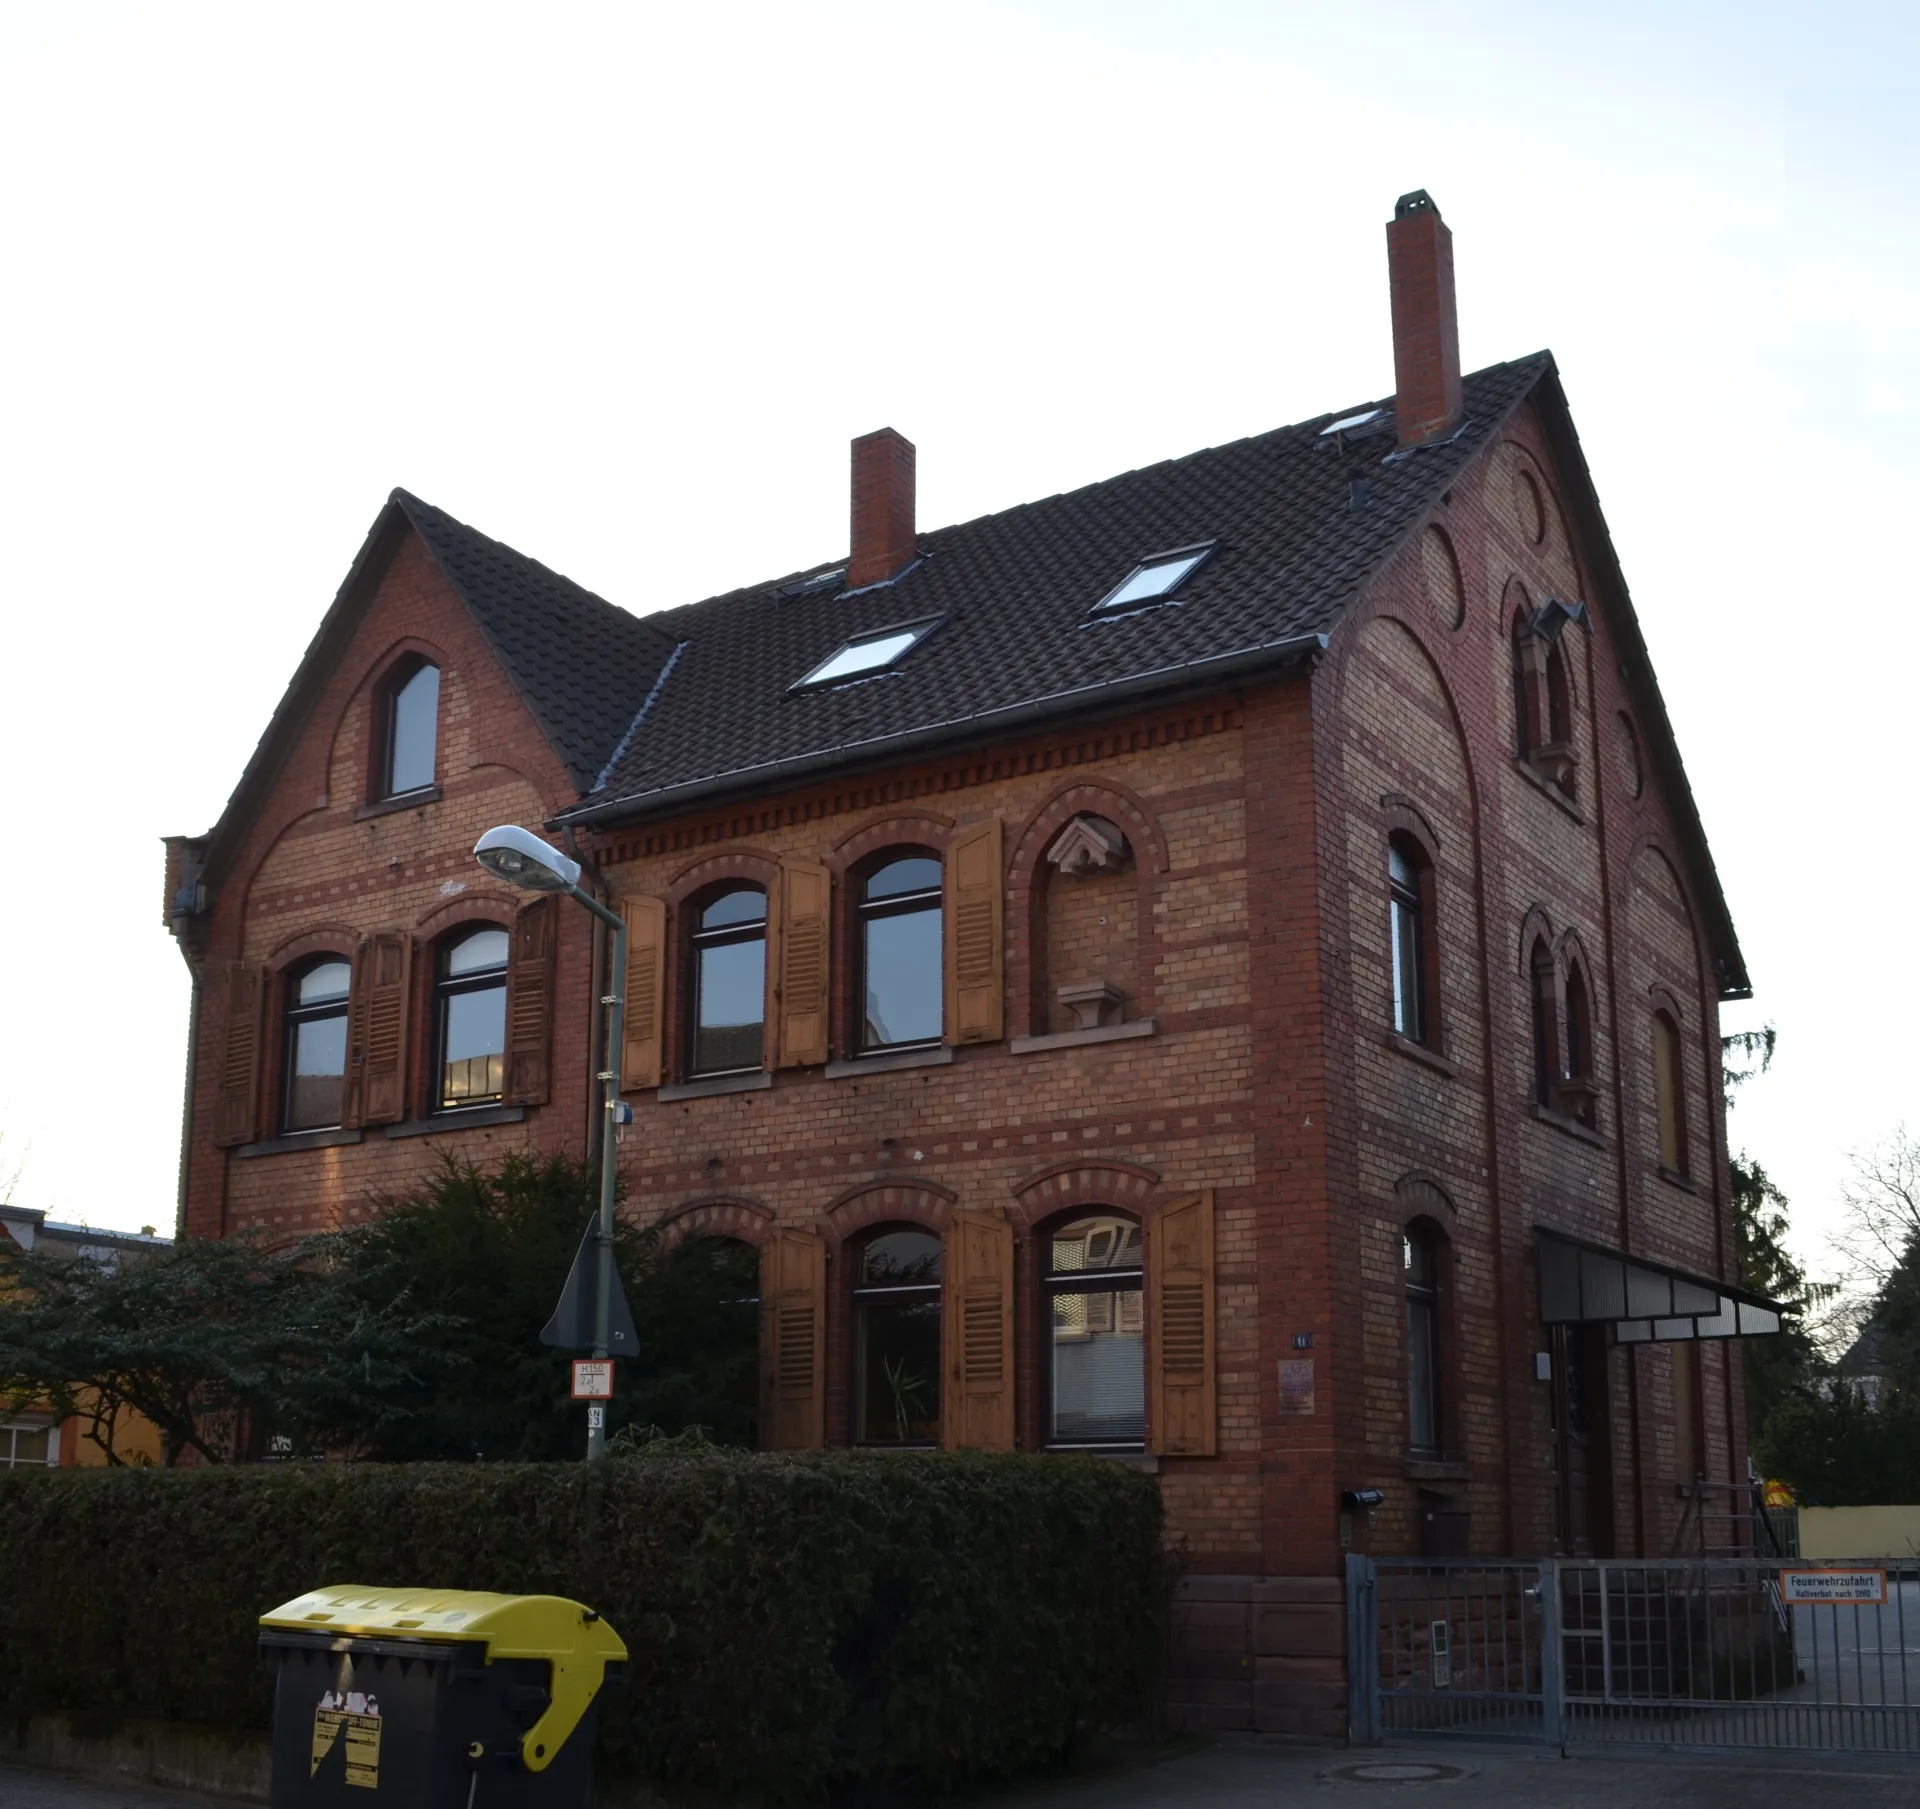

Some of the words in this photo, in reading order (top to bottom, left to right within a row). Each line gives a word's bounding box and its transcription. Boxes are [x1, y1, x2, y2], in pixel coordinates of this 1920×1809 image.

[1791, 1575, 1874, 1586] Feuerwehrzufahrt
[1796, 1589, 1832, 1598] Haltverbot
[1835, 1589, 1852, 1598] nach
[1855, 1589, 1871, 1598] StVO
